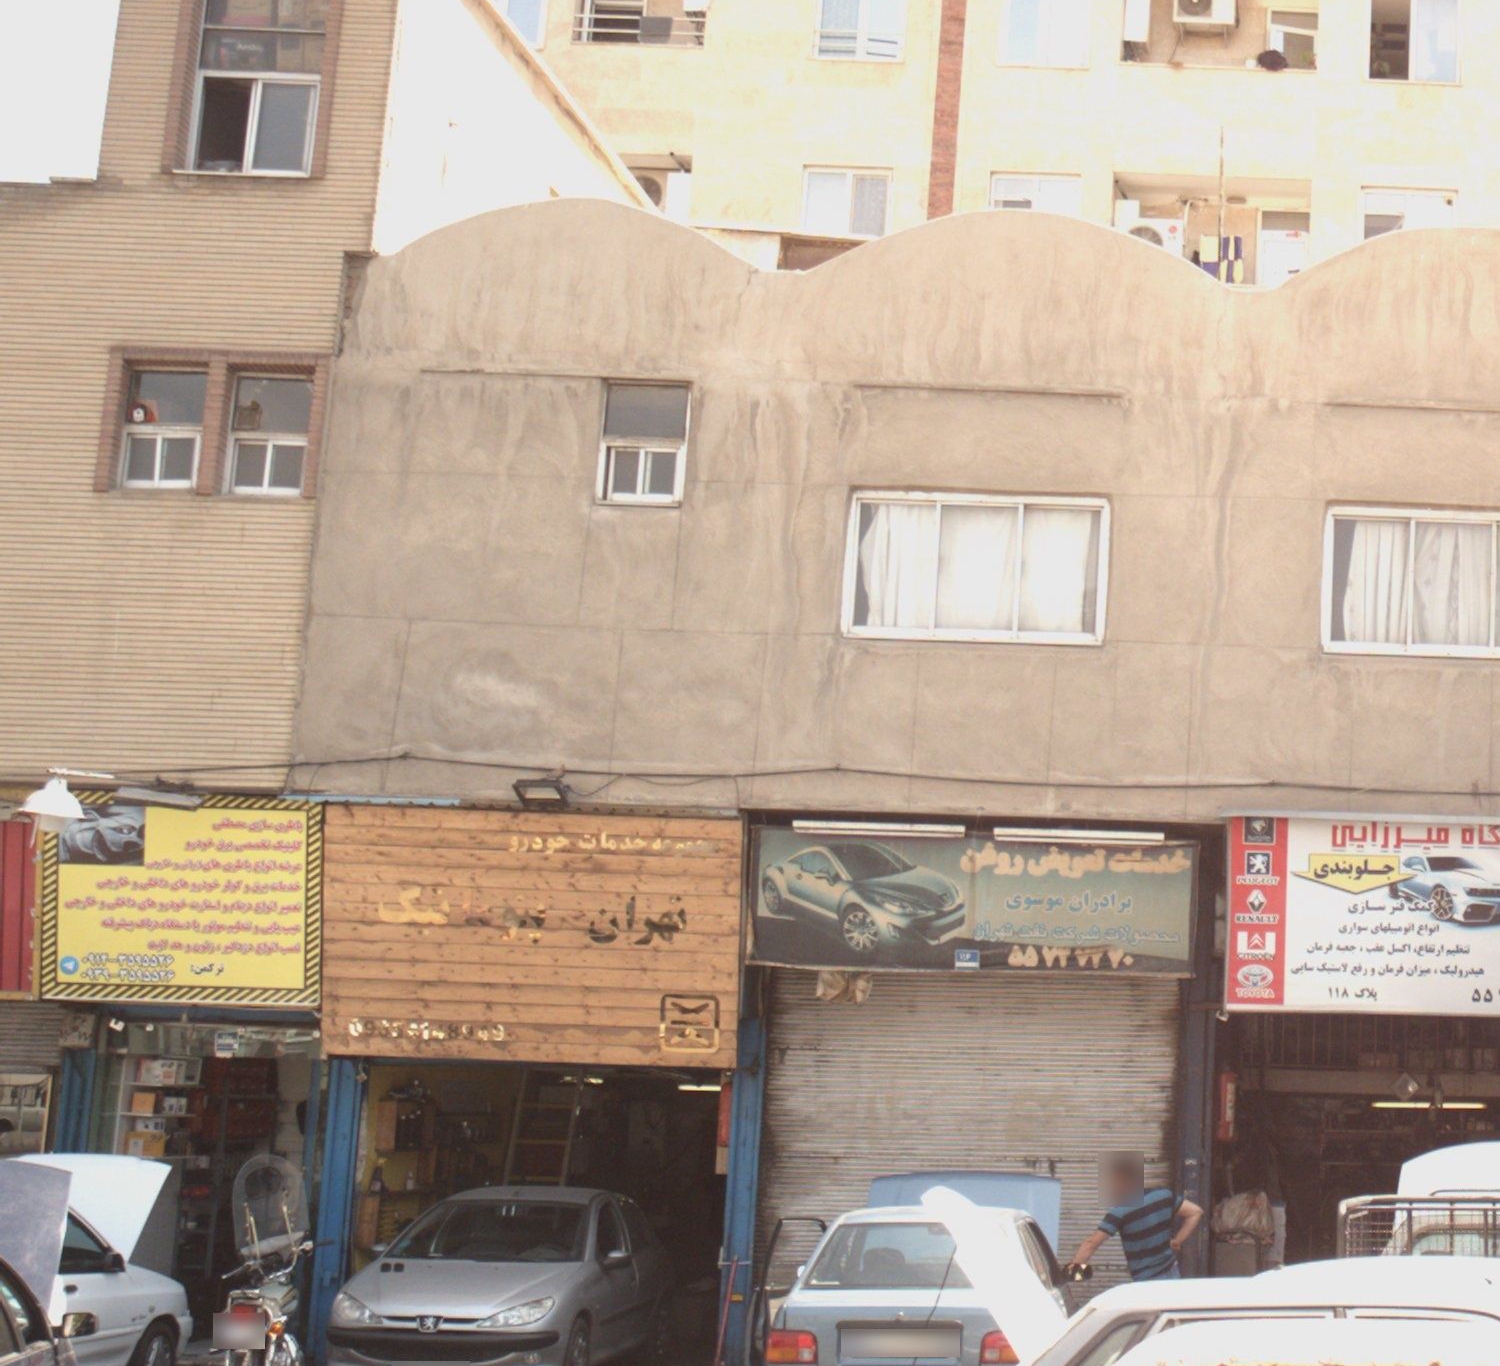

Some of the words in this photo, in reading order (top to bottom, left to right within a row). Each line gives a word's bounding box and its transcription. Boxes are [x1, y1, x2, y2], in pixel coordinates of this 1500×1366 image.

[248, 819, 273, 832] سازی
[578, 832, 646, 851] خدمات
[1331, 821, 1450, 851] میرزایی
[185, 837, 214, 851] خودرو
[509, 836, 569, 854] خودرو
[1313, 859, 1395, 881] جلوبندی
[270, 881, 301, 894] خدمات
[1236, 876, 1280, 885] PEUGEOT
[1005, 893, 1065, 912] موسوی
[1067, 891, 1133, 914] برادران
[1347, 899, 1386, 914] سازی
[587, 895, 686, 945] تهران
[1235, 914, 1279, 924] RENAULT
[1053, 924, 1101, 944] شرکت
[1338, 923, 1368, 934] سواری
[1417, 924, 1440, 935] انواع
[1306, 942, 1333, 954] فرمان
[1387, 943, 1411, 954] اکسل
[1446, 944, 1471, 956] تنظیم
[1315, 962, 1348, 973] لاستیک
[1350, 963, 1368, 977] رفع
[1369, 967, 1376, 977] و
[1377, 963, 1404, 977] فرمان
[1405, 963, 1431, 977] میزان
[1439, 964, 1485, 978] هیدرولیک
[1328, 987, 1349, 999] ۱۱۸
[1353, 987, 1378, 1002] پلاک
